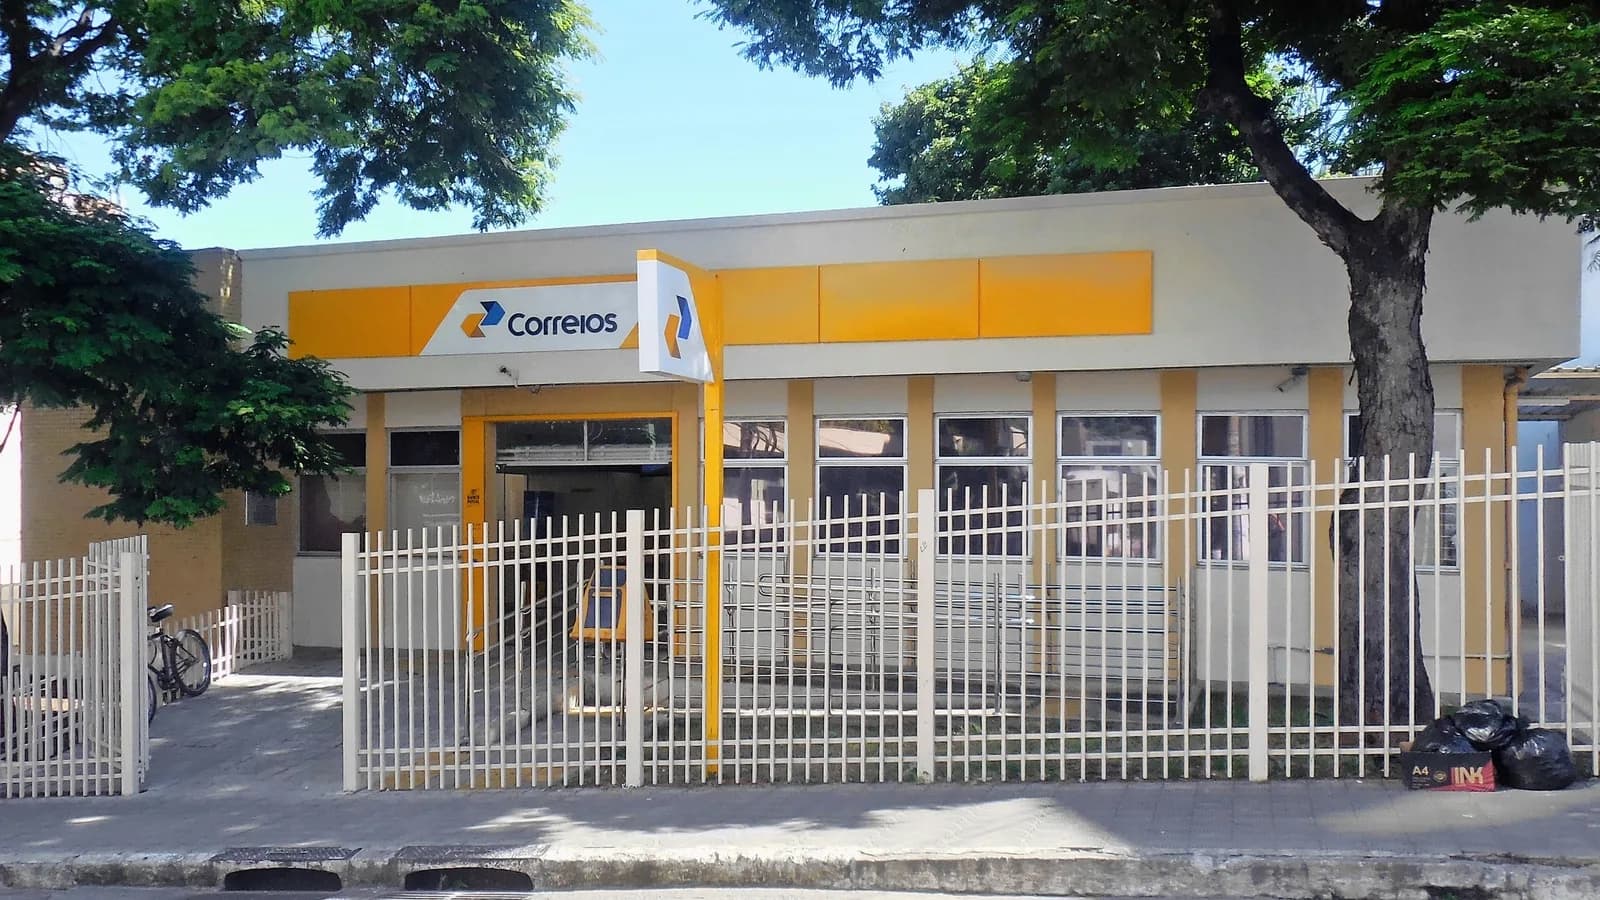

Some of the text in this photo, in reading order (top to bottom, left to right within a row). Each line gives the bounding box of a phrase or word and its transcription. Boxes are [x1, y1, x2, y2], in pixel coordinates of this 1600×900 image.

[508, 313, 618, 337] Correios
[1412, 765, 1429, 776] A4
[1454, 766, 1484, 785] INK
